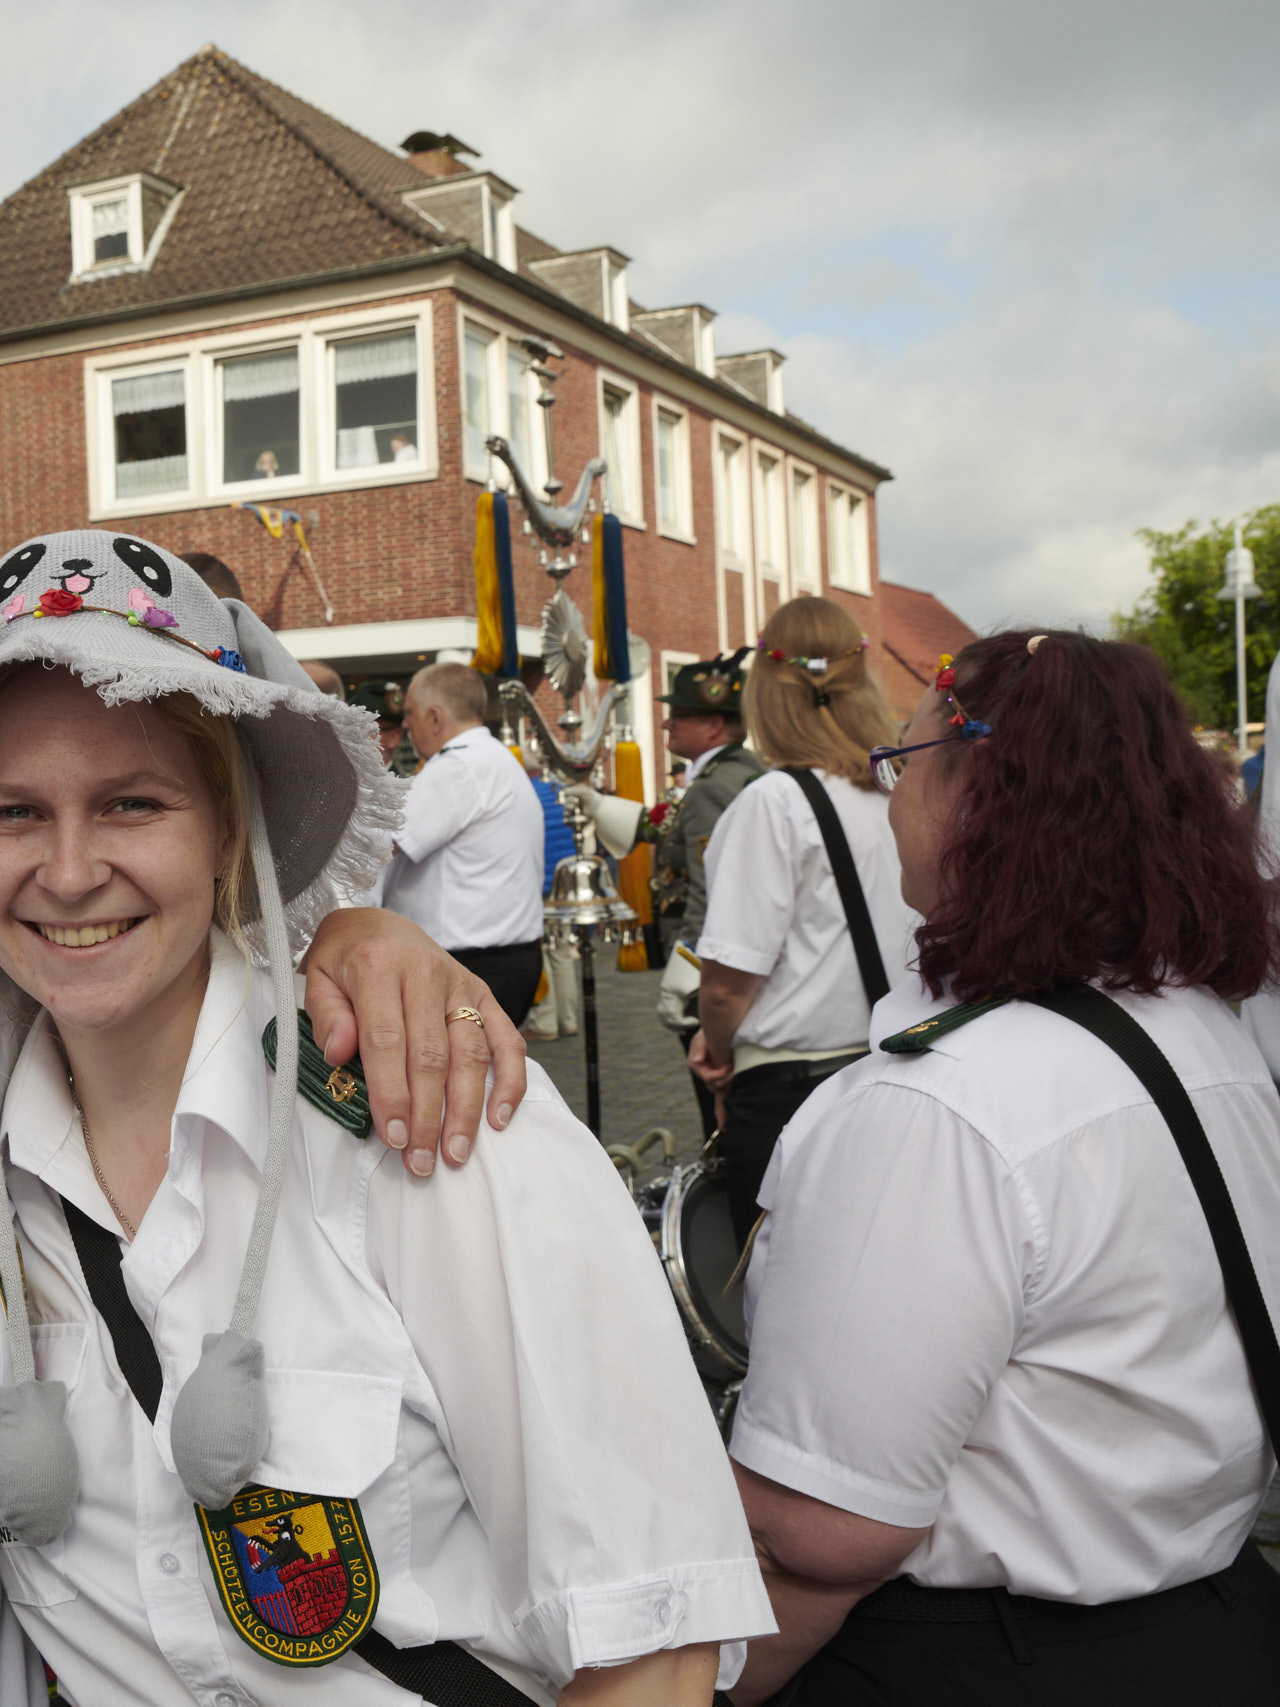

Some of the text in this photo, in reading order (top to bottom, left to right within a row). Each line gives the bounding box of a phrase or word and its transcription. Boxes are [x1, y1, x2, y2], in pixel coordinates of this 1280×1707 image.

[214, 1500, 368, 1657] SCHÜTZENCOMPAGNIE VON 1577
